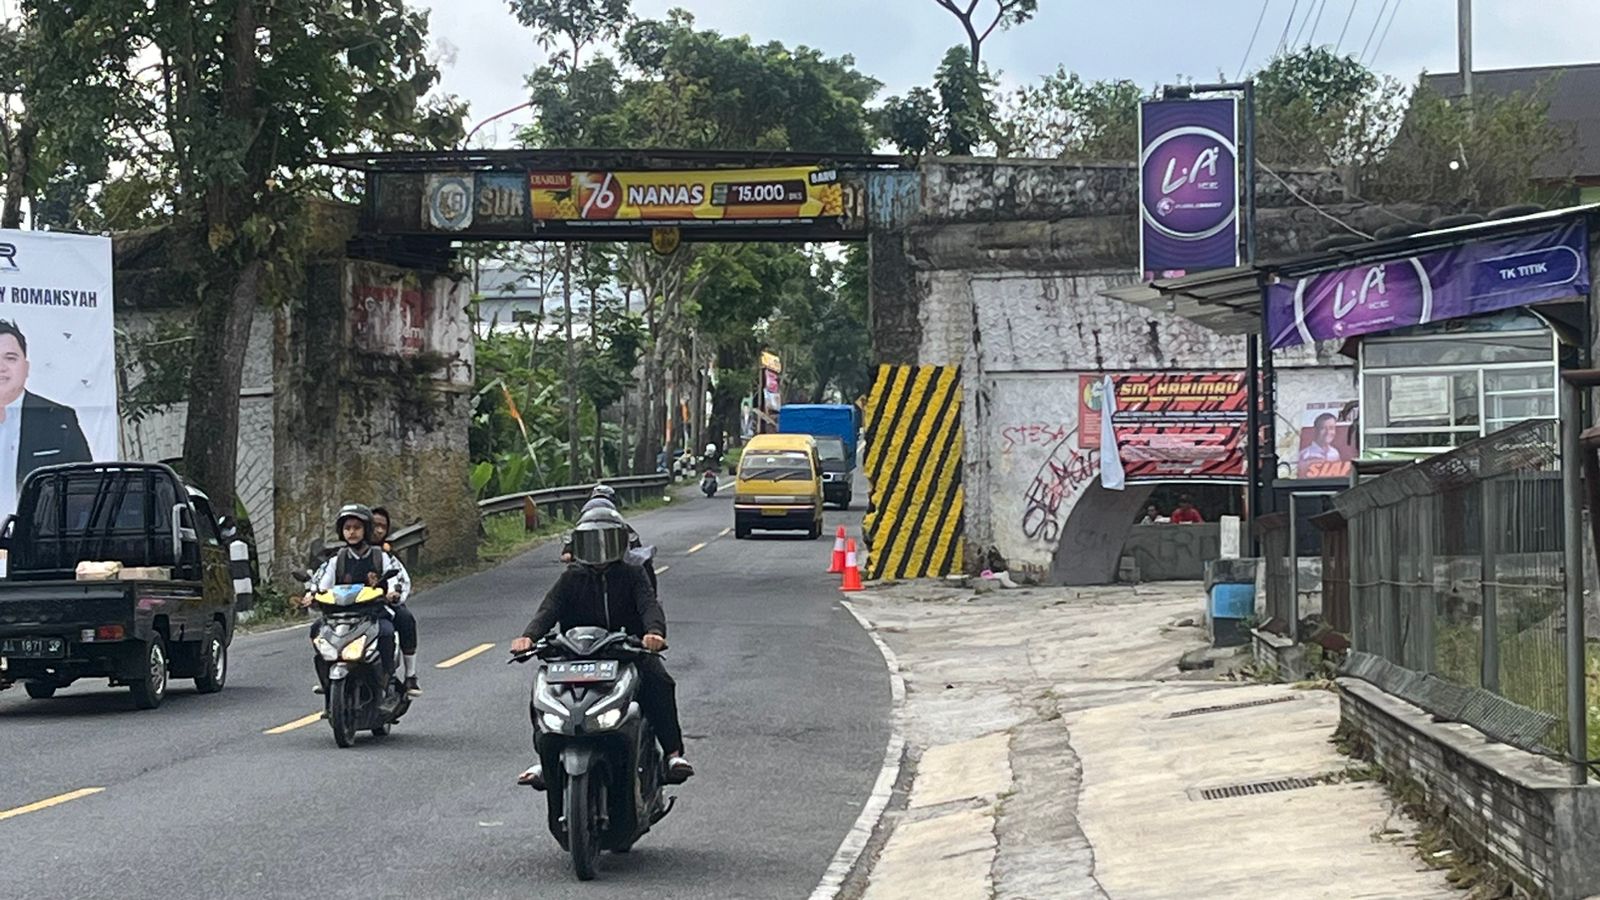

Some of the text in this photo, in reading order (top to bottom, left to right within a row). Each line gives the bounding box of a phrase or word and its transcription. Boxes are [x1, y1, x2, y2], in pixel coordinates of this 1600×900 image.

[581, 172, 615, 219] 76
[629, 185, 704, 205] NANAS
[737, 184, 785, 202] 15.000
[1500, 261, 1548, 280] TK TITIK
[12, 287, 97, 307] ROMANSYAH
[1120, 382, 1239, 395] SM HARIMAU
